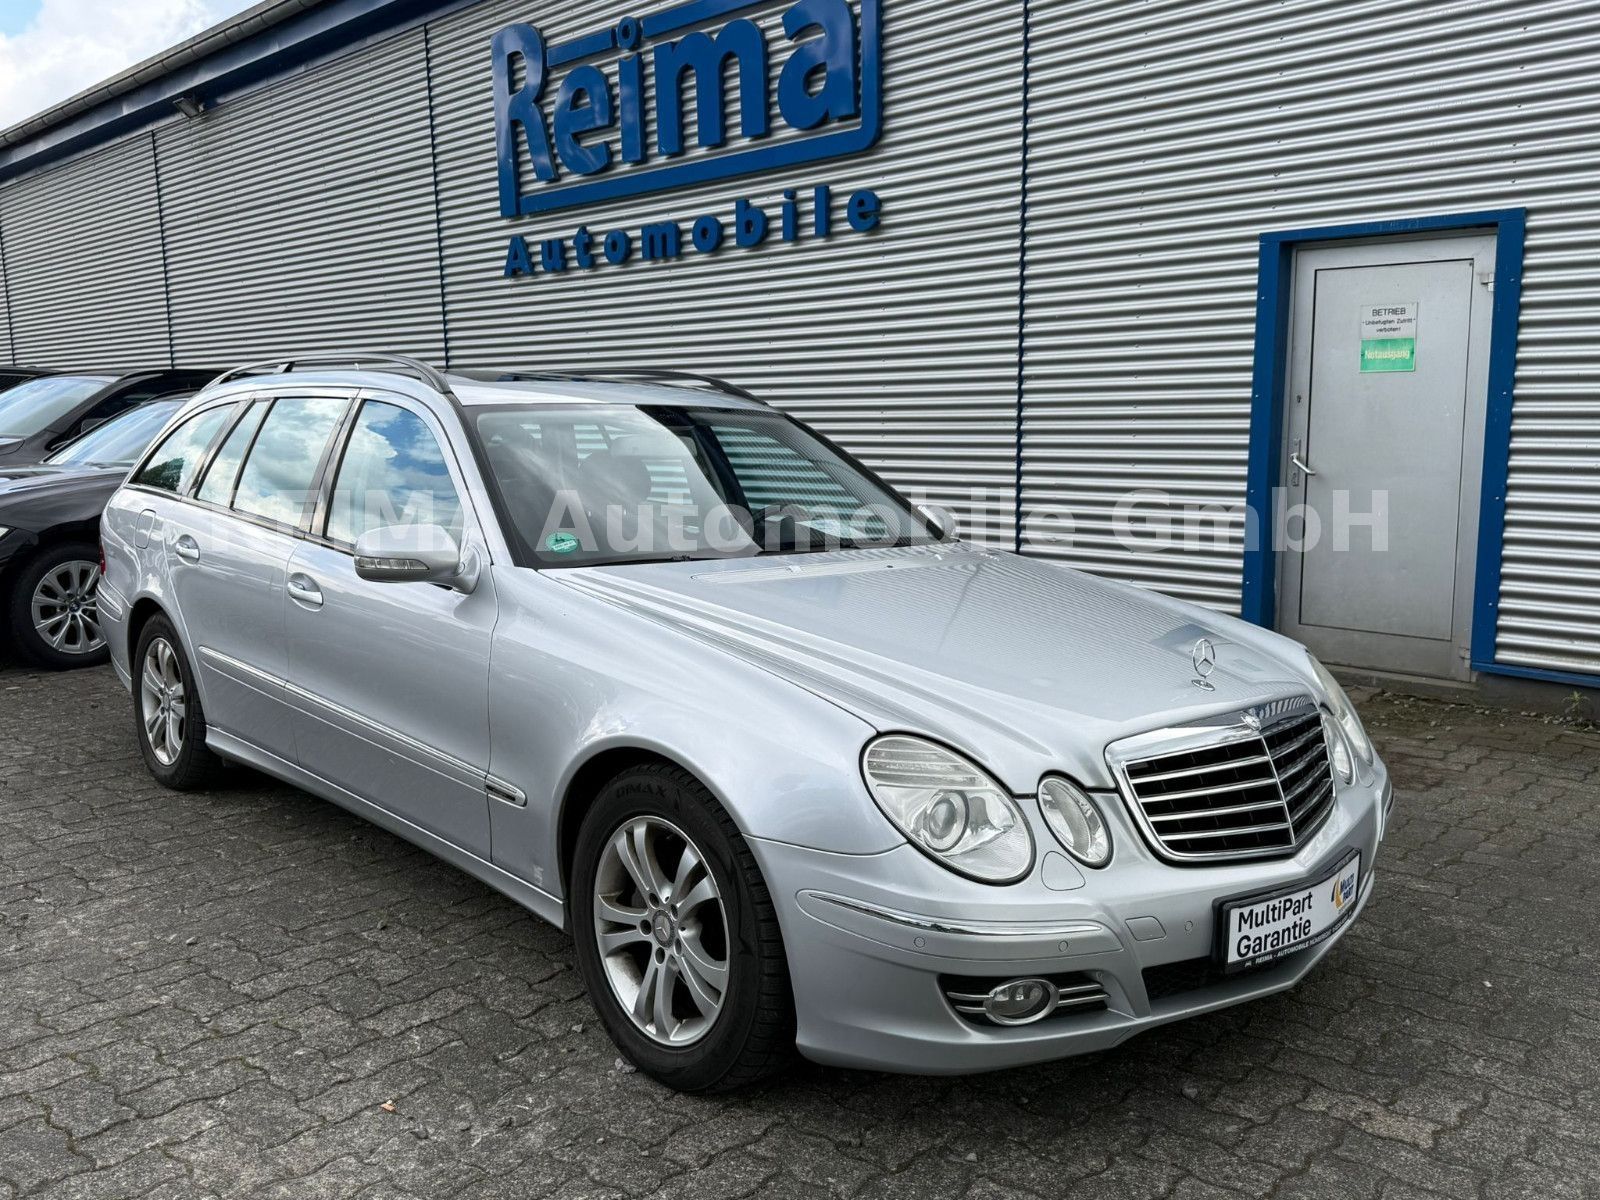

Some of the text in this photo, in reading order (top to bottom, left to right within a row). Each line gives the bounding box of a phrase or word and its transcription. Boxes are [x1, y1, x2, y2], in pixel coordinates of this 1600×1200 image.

[490, 0, 859, 217] Reima
[504, 186, 881, 277] Automobile
[1372, 307, 1406, 317] BETRIEB
[1364, 349, 1409, 360] Notausgang
[1238, 892, 1313, 932] MultiPart
[1237, 917, 1311, 957] Garantie
